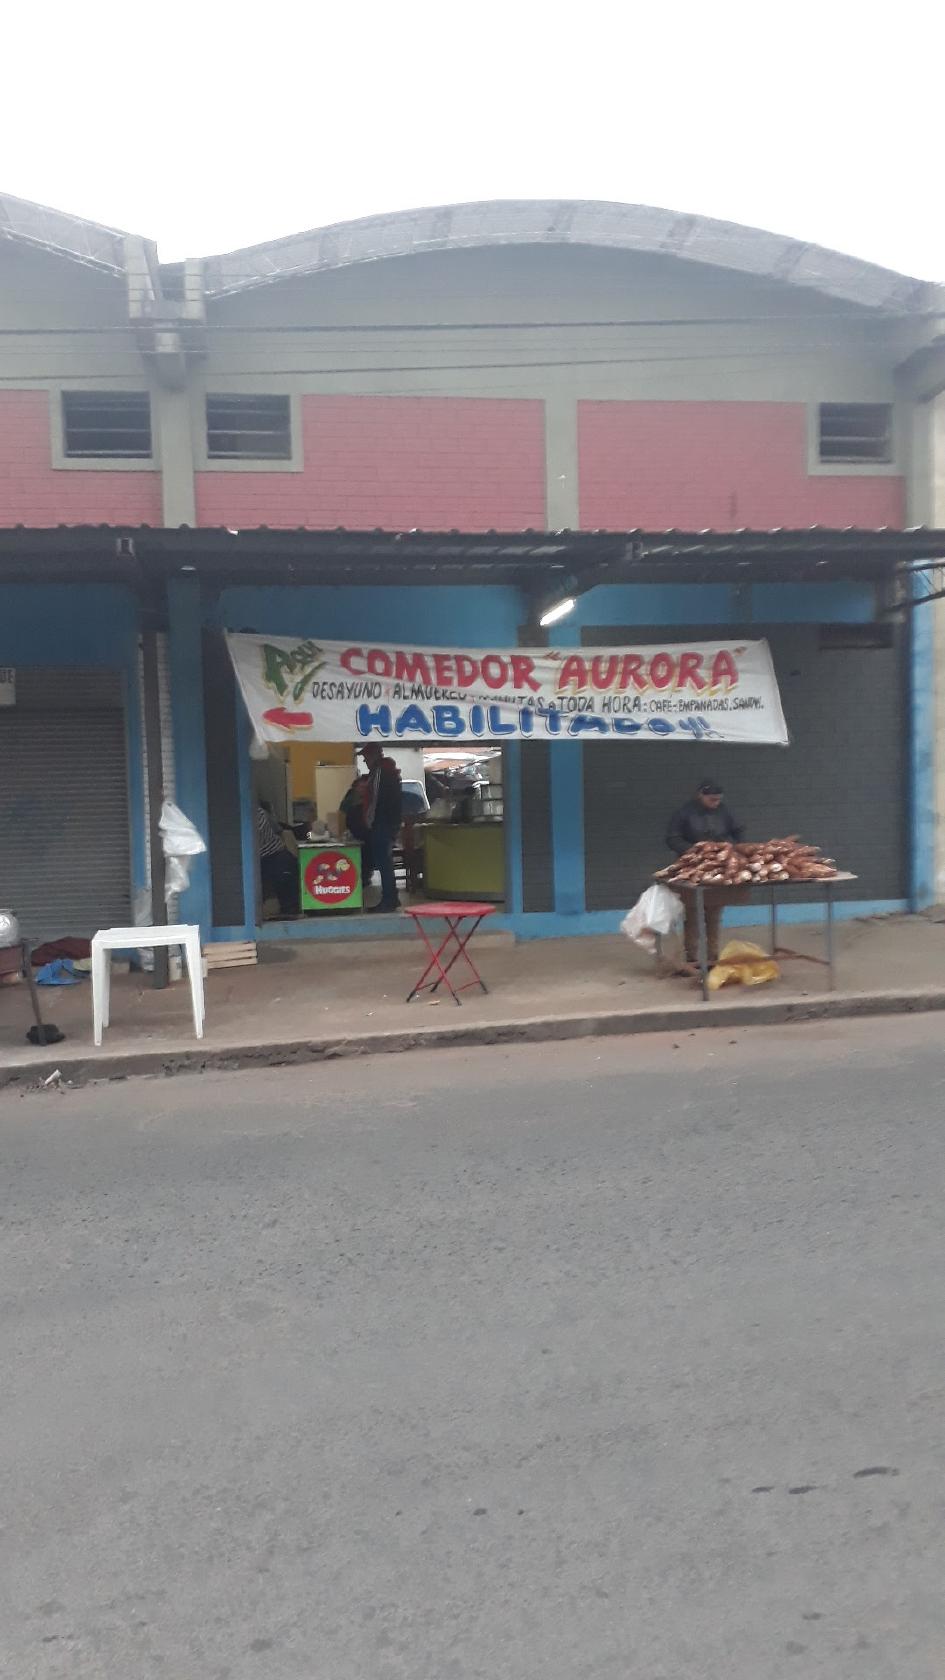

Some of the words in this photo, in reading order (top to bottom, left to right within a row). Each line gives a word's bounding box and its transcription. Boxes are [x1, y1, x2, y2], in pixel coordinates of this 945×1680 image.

[340, 647, 542, 692] COMEDOR
[312, 681, 382, 700] DESAYUNO
[557, 695, 595, 713] TODA
[315, 885, 351, 895] HUGGIES
